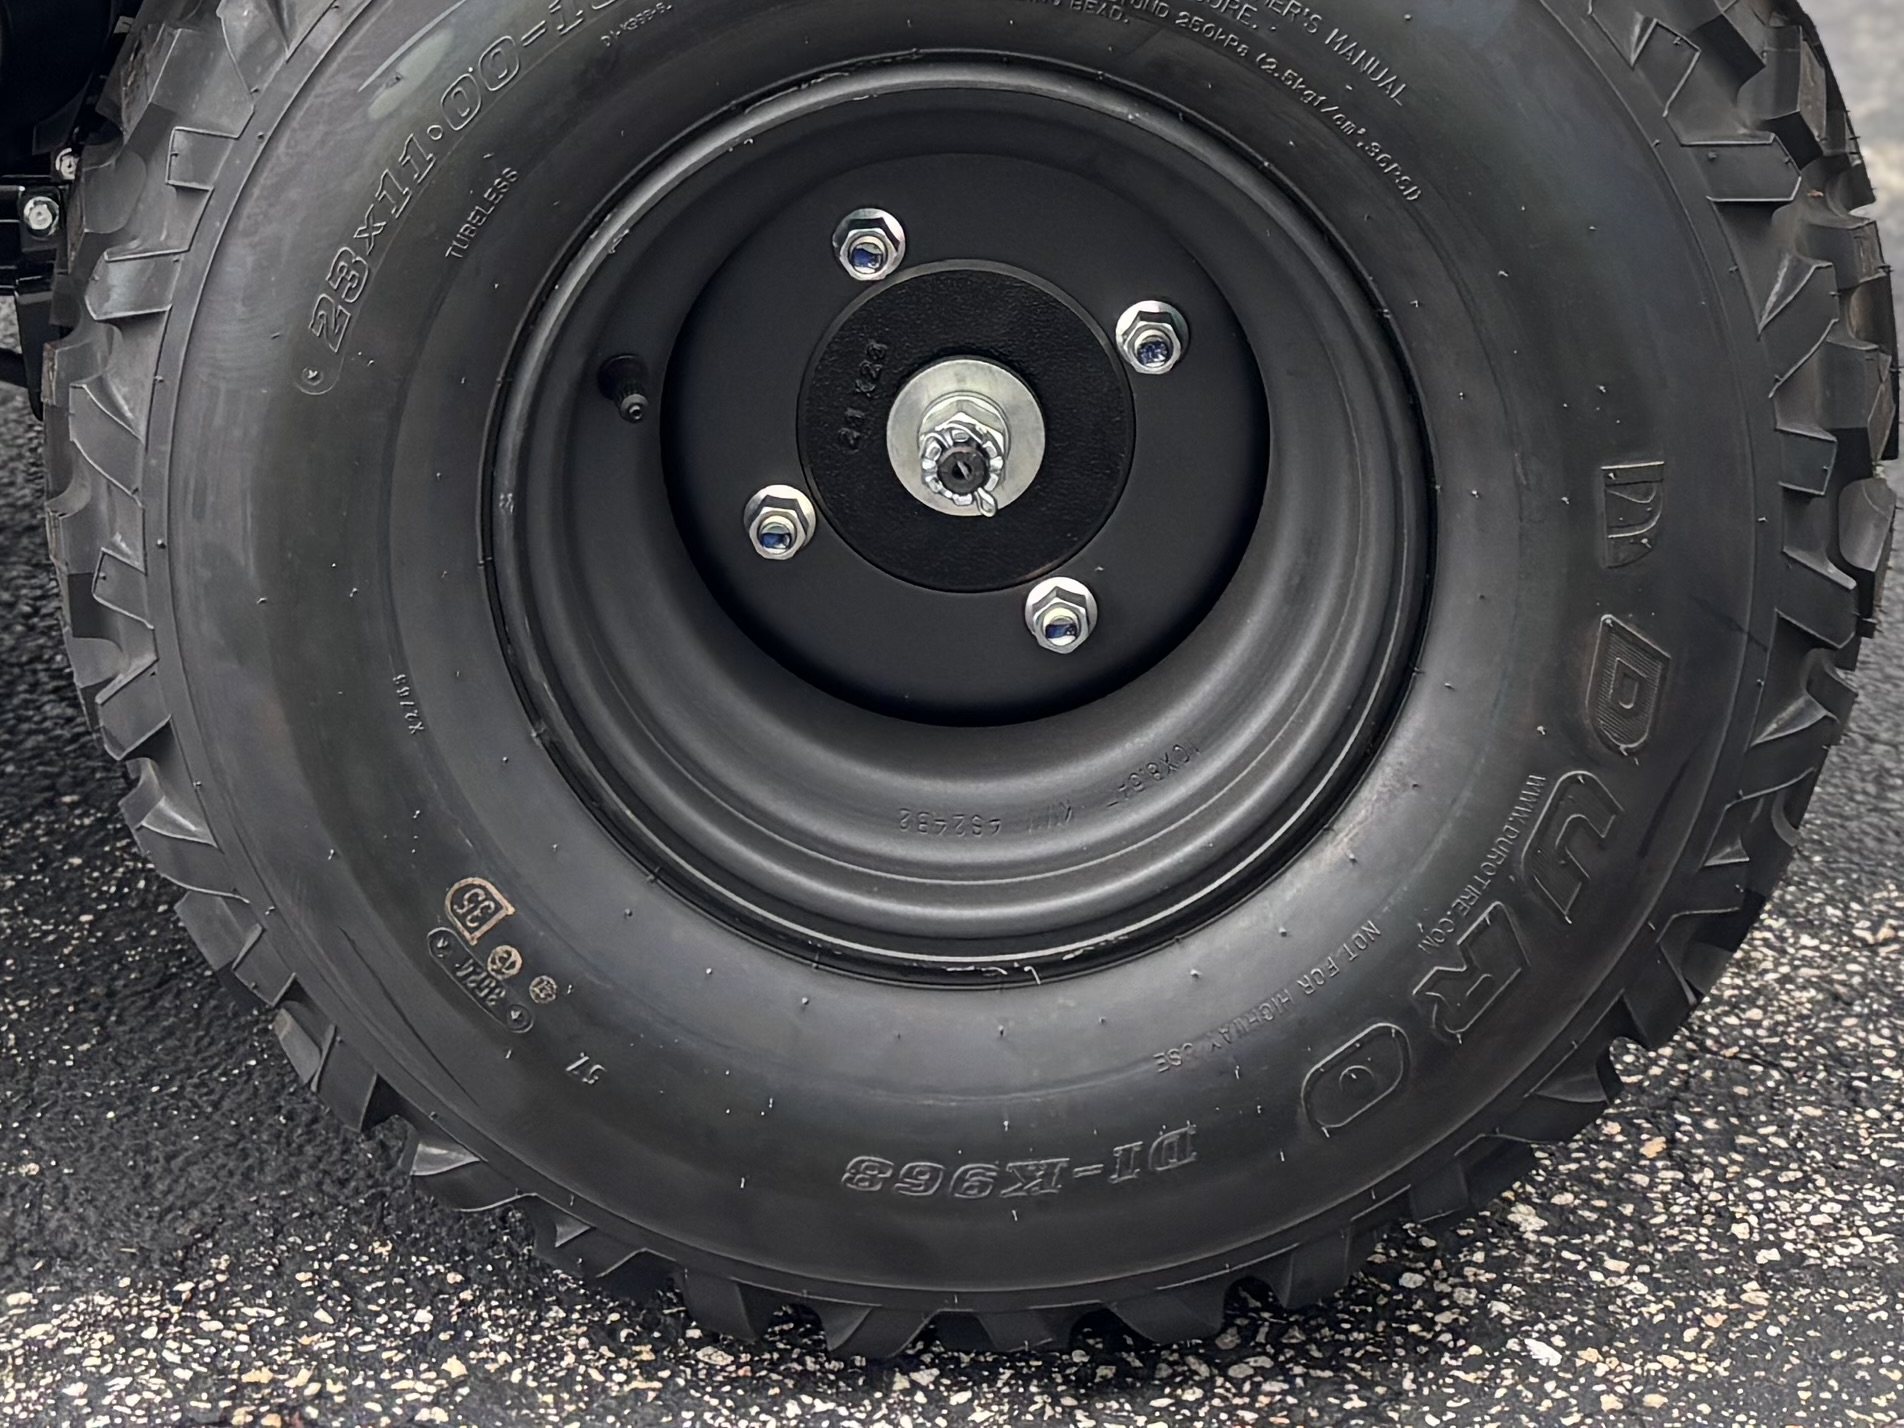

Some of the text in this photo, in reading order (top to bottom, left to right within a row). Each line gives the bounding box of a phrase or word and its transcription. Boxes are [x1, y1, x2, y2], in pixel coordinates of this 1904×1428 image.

[1324, 27, 1407, 106] MANUAL
[445, 166, 520, 260] TUBELESS
[1301, 612, 1673, 1130] DURO
[1296, 955, 1341, 996] FOR
[1347, 918, 1382, 962] NOT
